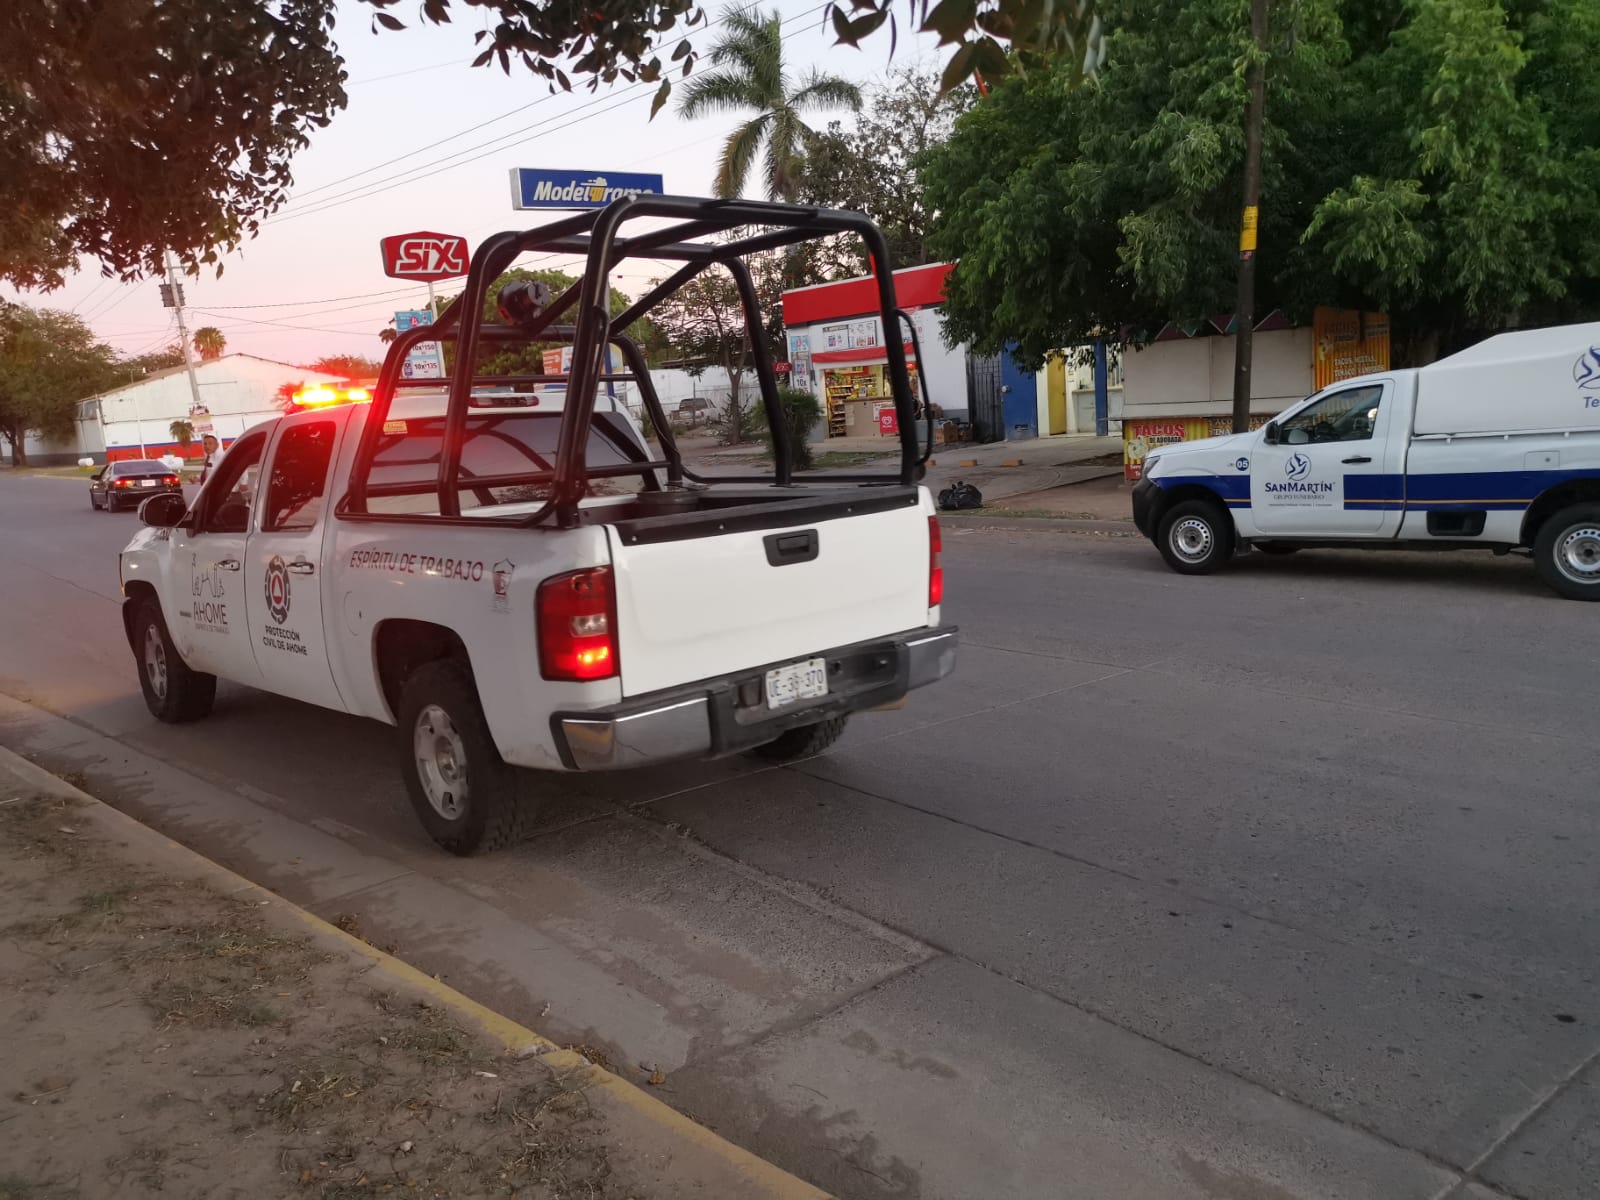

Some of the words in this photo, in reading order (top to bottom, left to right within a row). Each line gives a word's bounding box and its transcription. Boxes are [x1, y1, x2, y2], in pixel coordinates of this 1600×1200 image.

[1133, 423, 1185, 437] TACOS
[1236, 460, 1249, 469] 05
[350, 547, 399, 570] ESPÍRITU
[399, 553, 417, 573] DE
[420, 556, 484, 582] TRABAJO
[193, 601, 228, 625] AHOME
[265, 624, 300, 641] PROTECCIÓN
[263, 636, 277, 648] CIVIL
[277, 639, 285, 650] DE
[286, 643, 308, 656] AHOME
